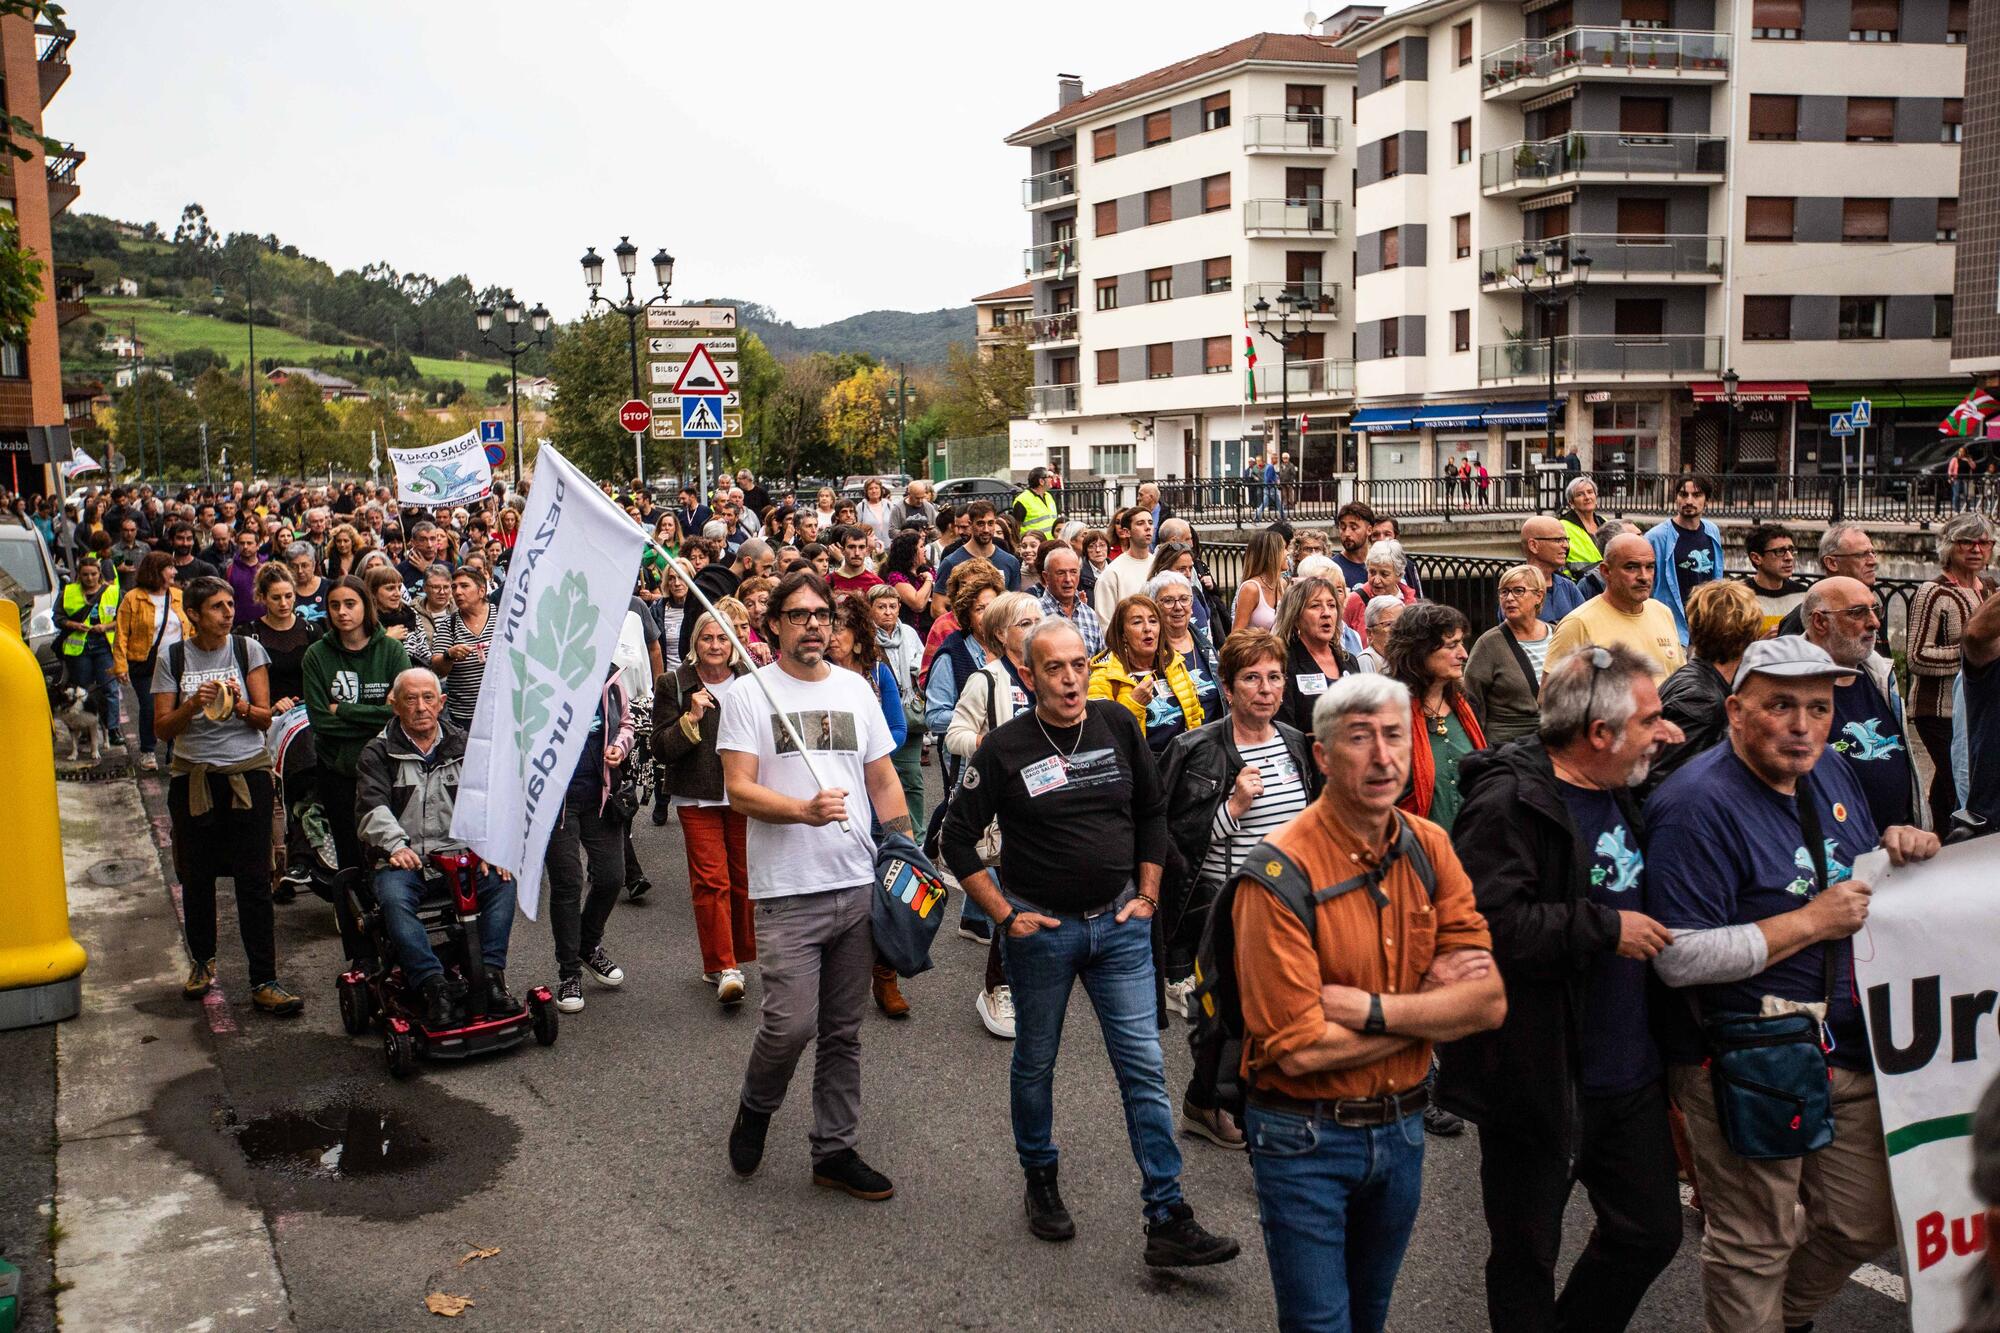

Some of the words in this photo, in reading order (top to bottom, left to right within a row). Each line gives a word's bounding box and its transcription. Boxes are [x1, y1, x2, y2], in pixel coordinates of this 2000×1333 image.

[648, 309, 676, 317] Urbieta
[655, 365, 680, 373] BILBO
[623, 411, 649, 421] STOP
[407, 451, 439, 461] DAGO
[1867, 974, 2000, 1076] Ur
